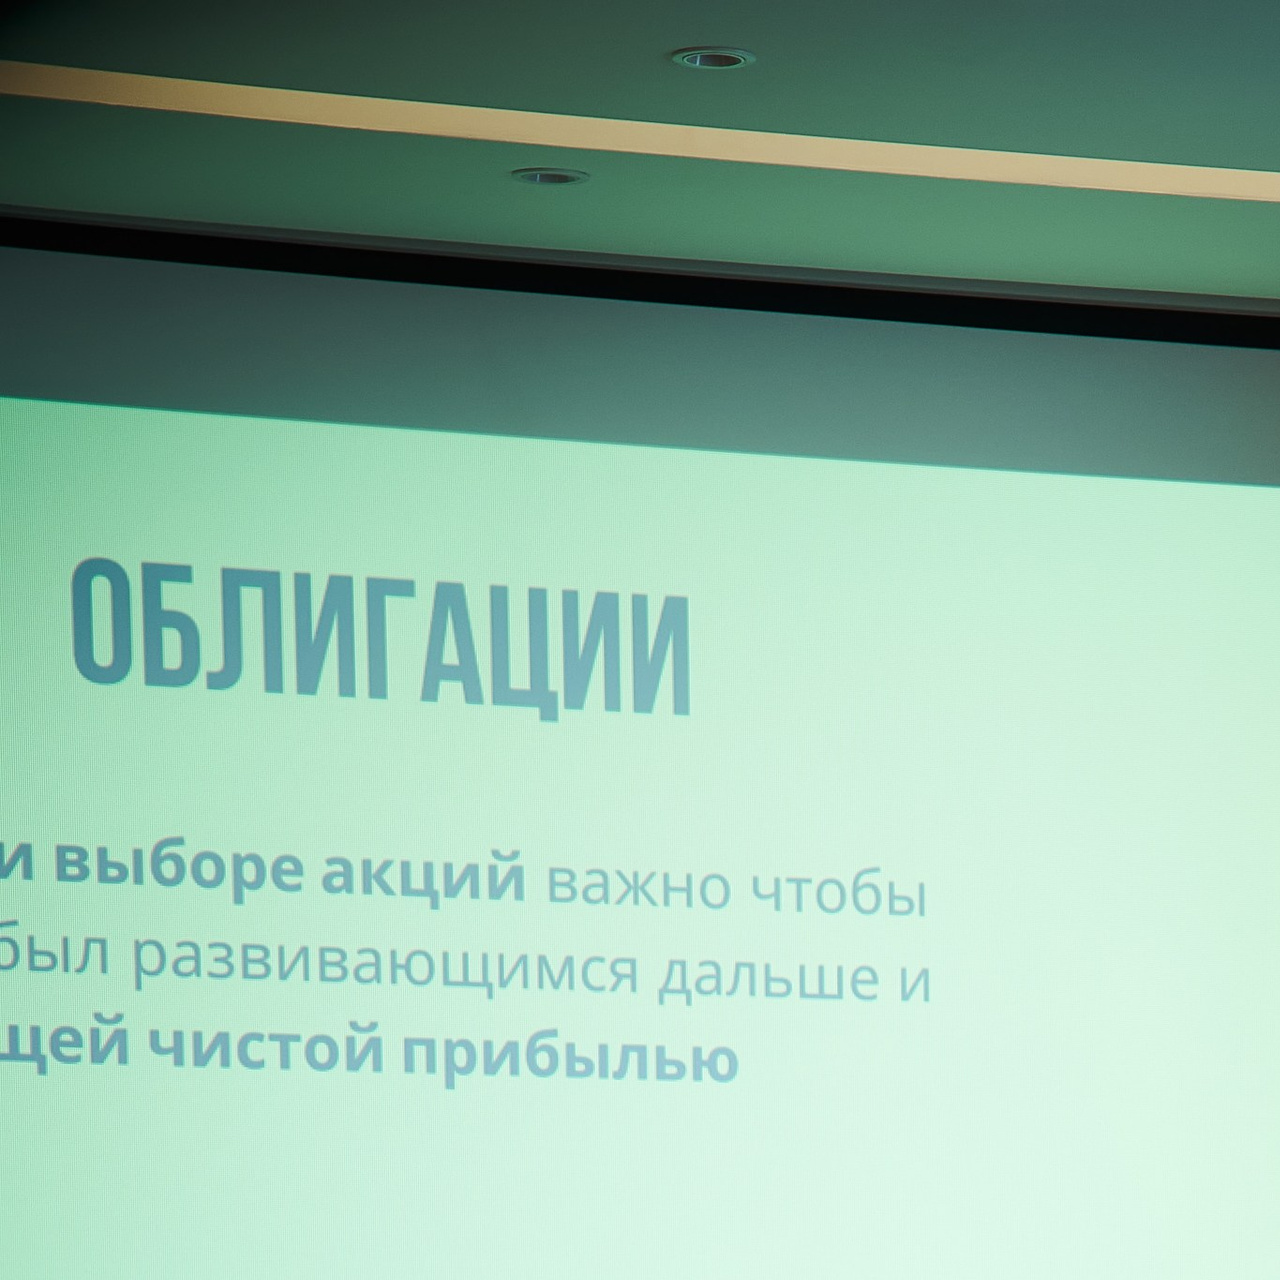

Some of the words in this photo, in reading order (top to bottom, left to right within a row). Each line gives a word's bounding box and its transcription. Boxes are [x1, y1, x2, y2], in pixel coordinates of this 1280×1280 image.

[71, 557, 690, 722] ОБЛИГАЦИИ
[55, 836, 304, 905] выборе
[321, 850, 526, 910] акций
[548, 866, 731, 909] важно
[752, 866, 926, 917] чтобы
[133, 936, 638, 999] развивающимся
[658, 958, 880, 1006] дальше
[900, 967, 931, 1002] и
[149, 1020, 384, 1073] чистой
[403, 1028, 739, 1089] прибылью
